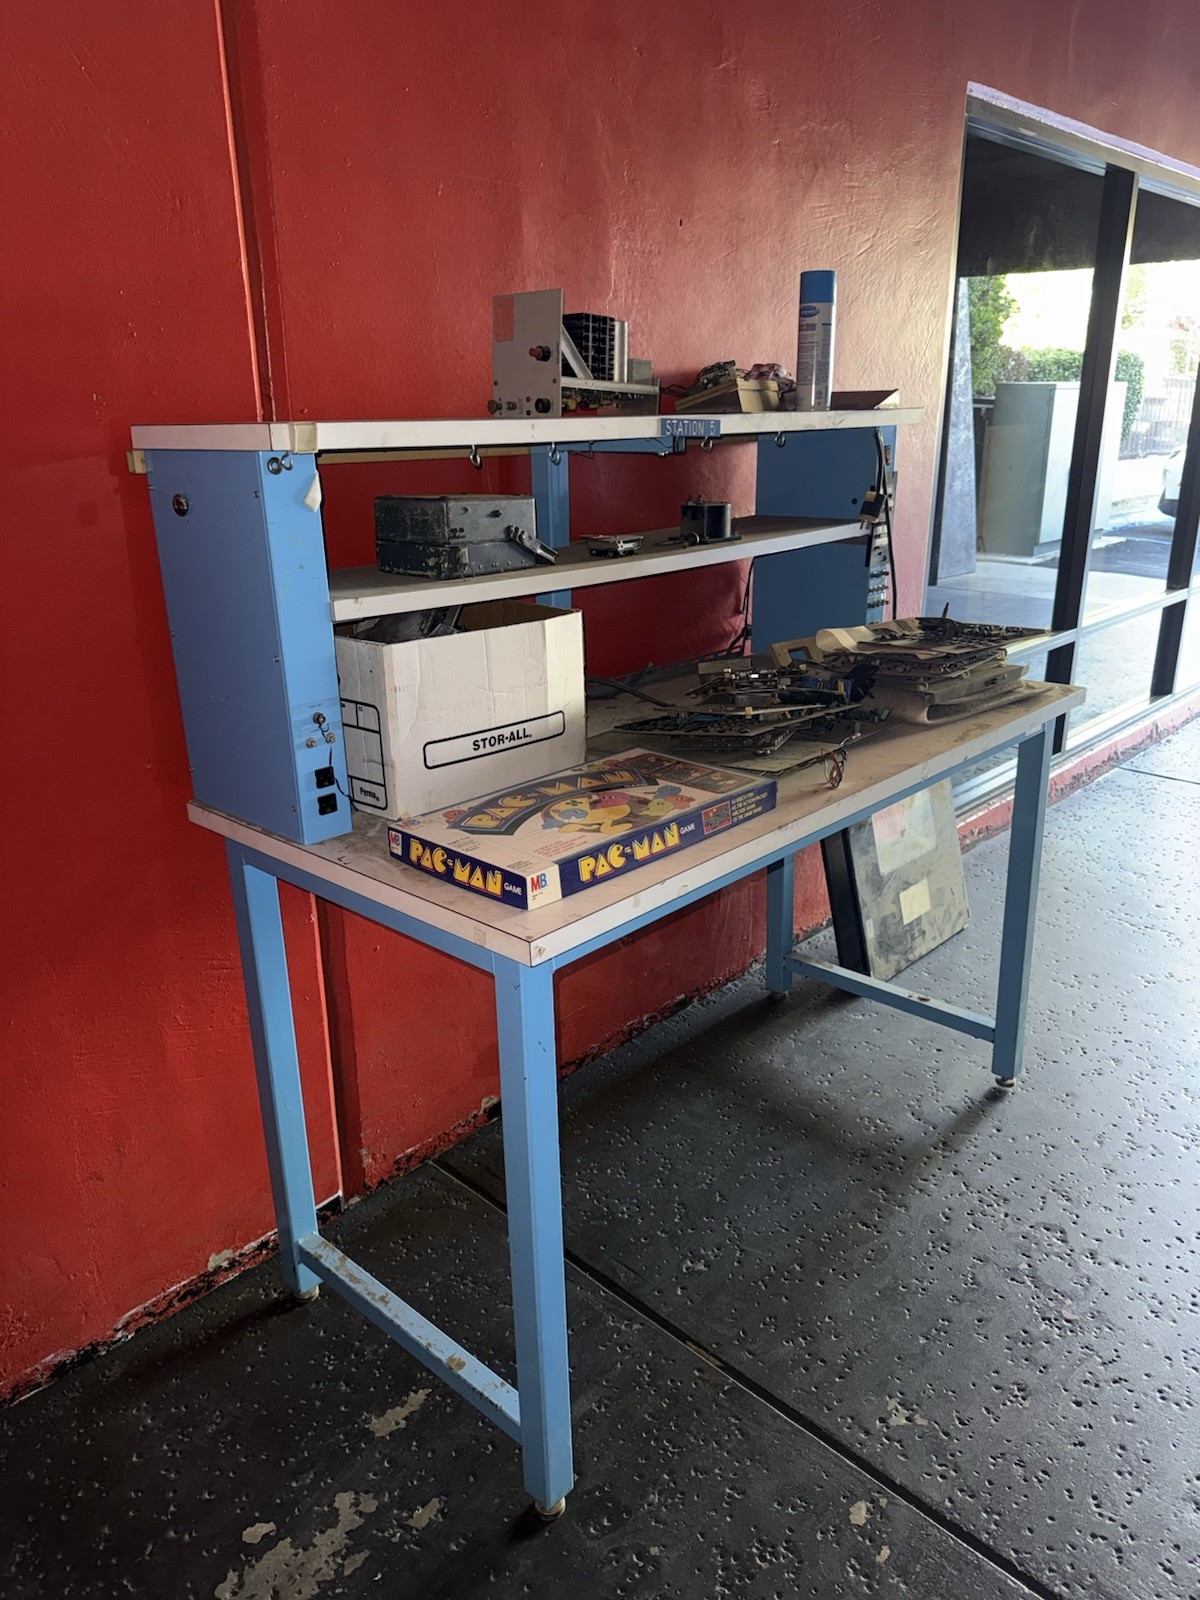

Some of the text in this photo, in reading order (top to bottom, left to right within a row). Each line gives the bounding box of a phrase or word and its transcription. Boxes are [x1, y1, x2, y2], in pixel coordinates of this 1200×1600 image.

[665, 420, 716, 436] STATION 5
[409, 838, 503, 898] PAC-MAN
[504, 882, 522, 896] GAME
[578, 821, 681, 883] PAC-MAN
[680, 823, 696, 835] GAME
[530, 873, 548, 892] MB
